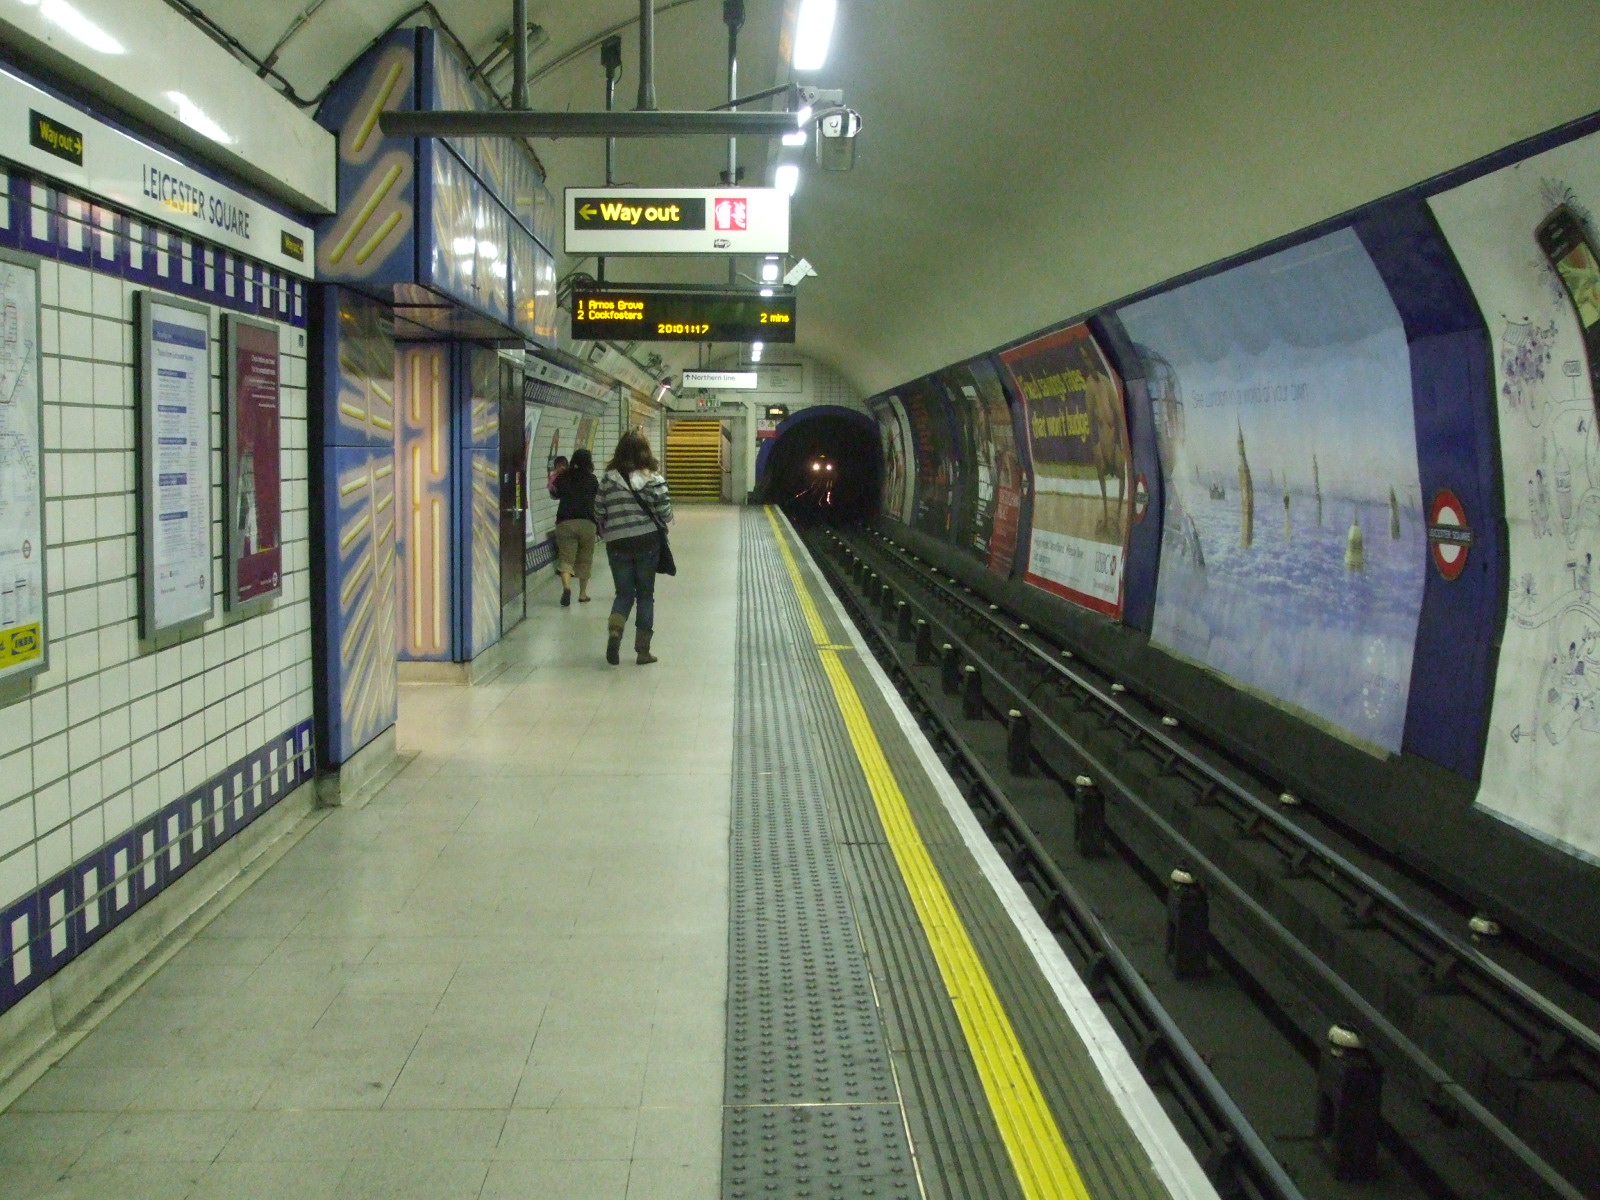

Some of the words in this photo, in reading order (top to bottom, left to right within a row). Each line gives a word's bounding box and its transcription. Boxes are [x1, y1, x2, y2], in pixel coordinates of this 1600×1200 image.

[39, 120, 58, 149] Way
[58, 133, 73, 152] out
[142, 163, 205, 220] LEICESTER
[208, 195, 250, 239] SQUARE
[600, 202, 642, 225] Way
[644, 204, 680, 222] out
[578, 300, 584, 310] 1
[588, 300, 615, 311] Arnos
[617, 300, 644, 311] Grove
[577, 310, 585, 321] 2
[588, 310, 643, 321] Cockfosters
[760, 313, 768, 323] 2
[769, 313, 790, 324] mins
[657, 323, 710, 335] 20:01:17
[691, 373, 722, 383] Northern
[722, 373, 736, 383] line
[1032, 411, 1048, 438] that
[1046, 407, 1067, 436] won't
[1065, 405, 1090, 443] budge
[1094, 551, 1110, 575] HSBC
[15, 635, 34, 649] IKEA
